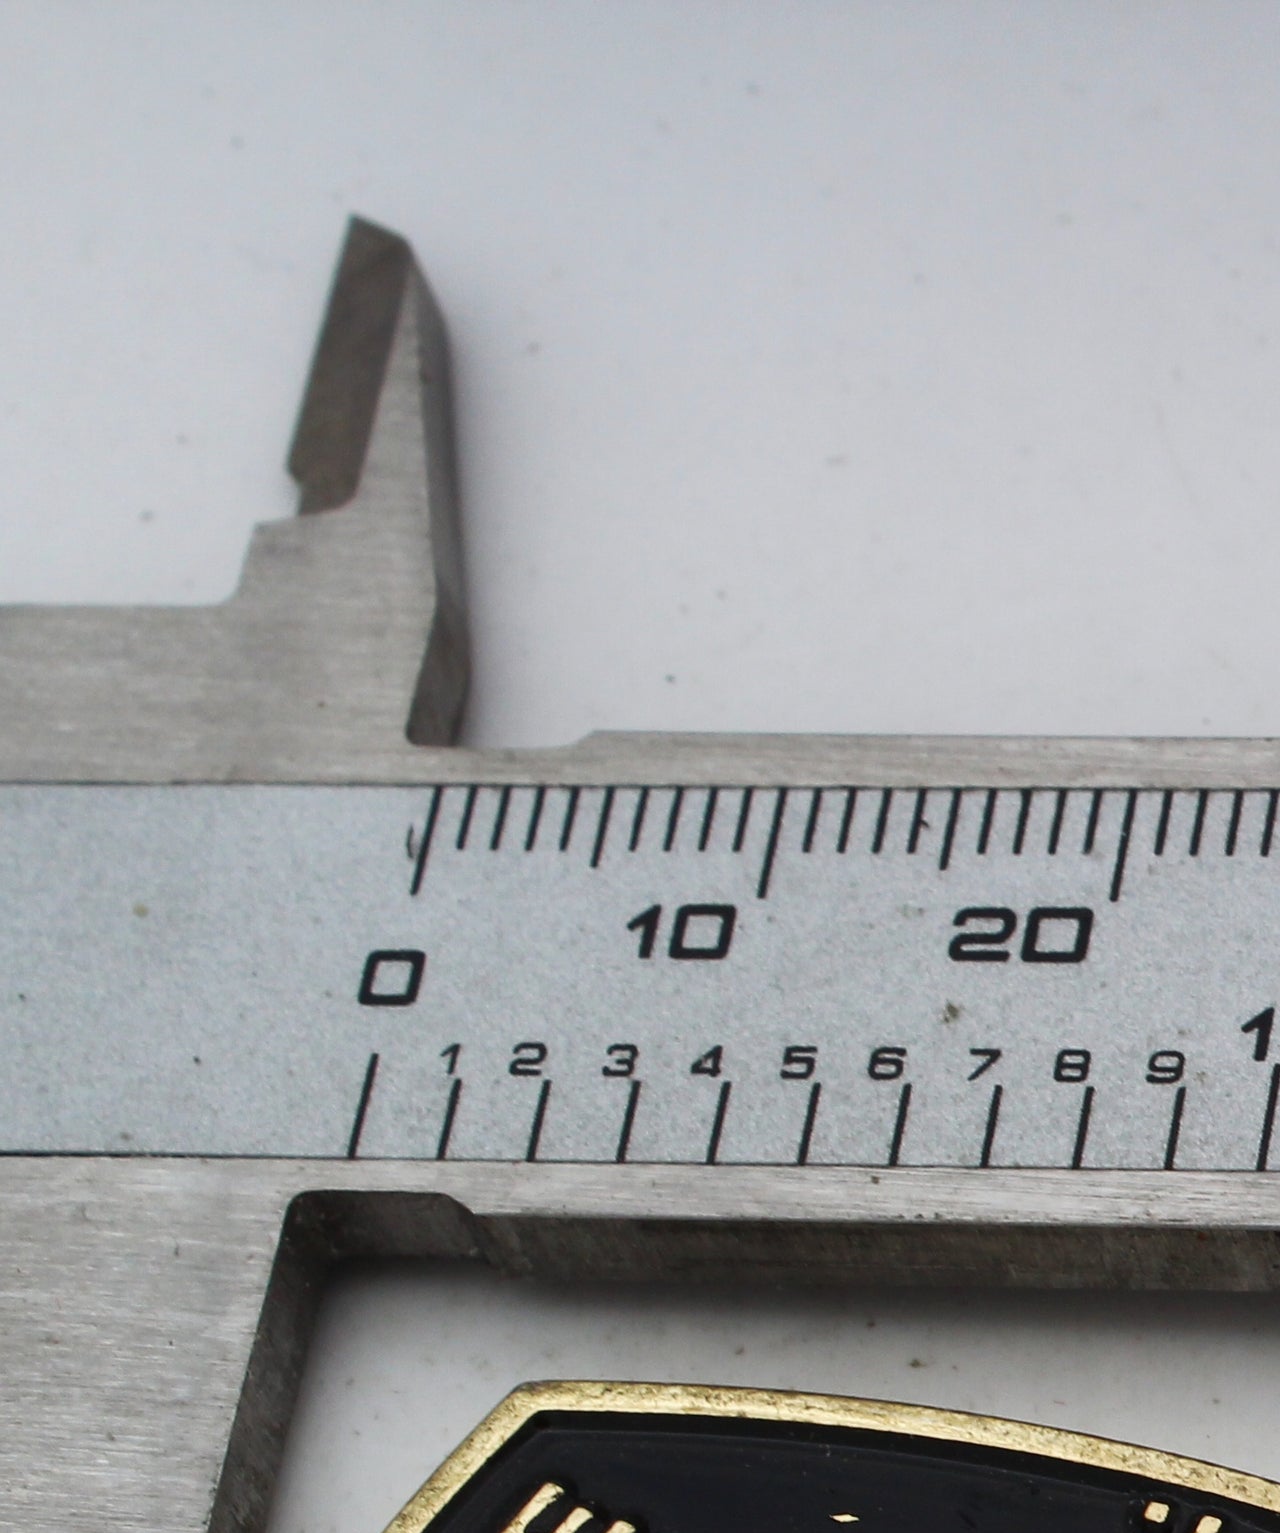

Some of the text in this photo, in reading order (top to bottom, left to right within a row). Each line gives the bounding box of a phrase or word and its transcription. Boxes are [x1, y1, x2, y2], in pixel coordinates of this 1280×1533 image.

[358, 949, 426, 1007] 0
[627, 903, 737, 960] 10
[948, 906, 1094, 963] 20
[439, 1043, 461, 1076] 1
[509, 1042, 548, 1077] 2
[602, 1043, 639, 1078] 3
[690, 1045, 723, 1078] 4
[780, 1045, 818, 1080] 5
[867, 1046, 907, 1081] 6
[967, 1048, 1002, 1081] 7
[1053, 1049, 1092, 1083] 8
[1145, 1050, 1186, 1085] 9
[1241, 1007, 1275, 1062] 1
